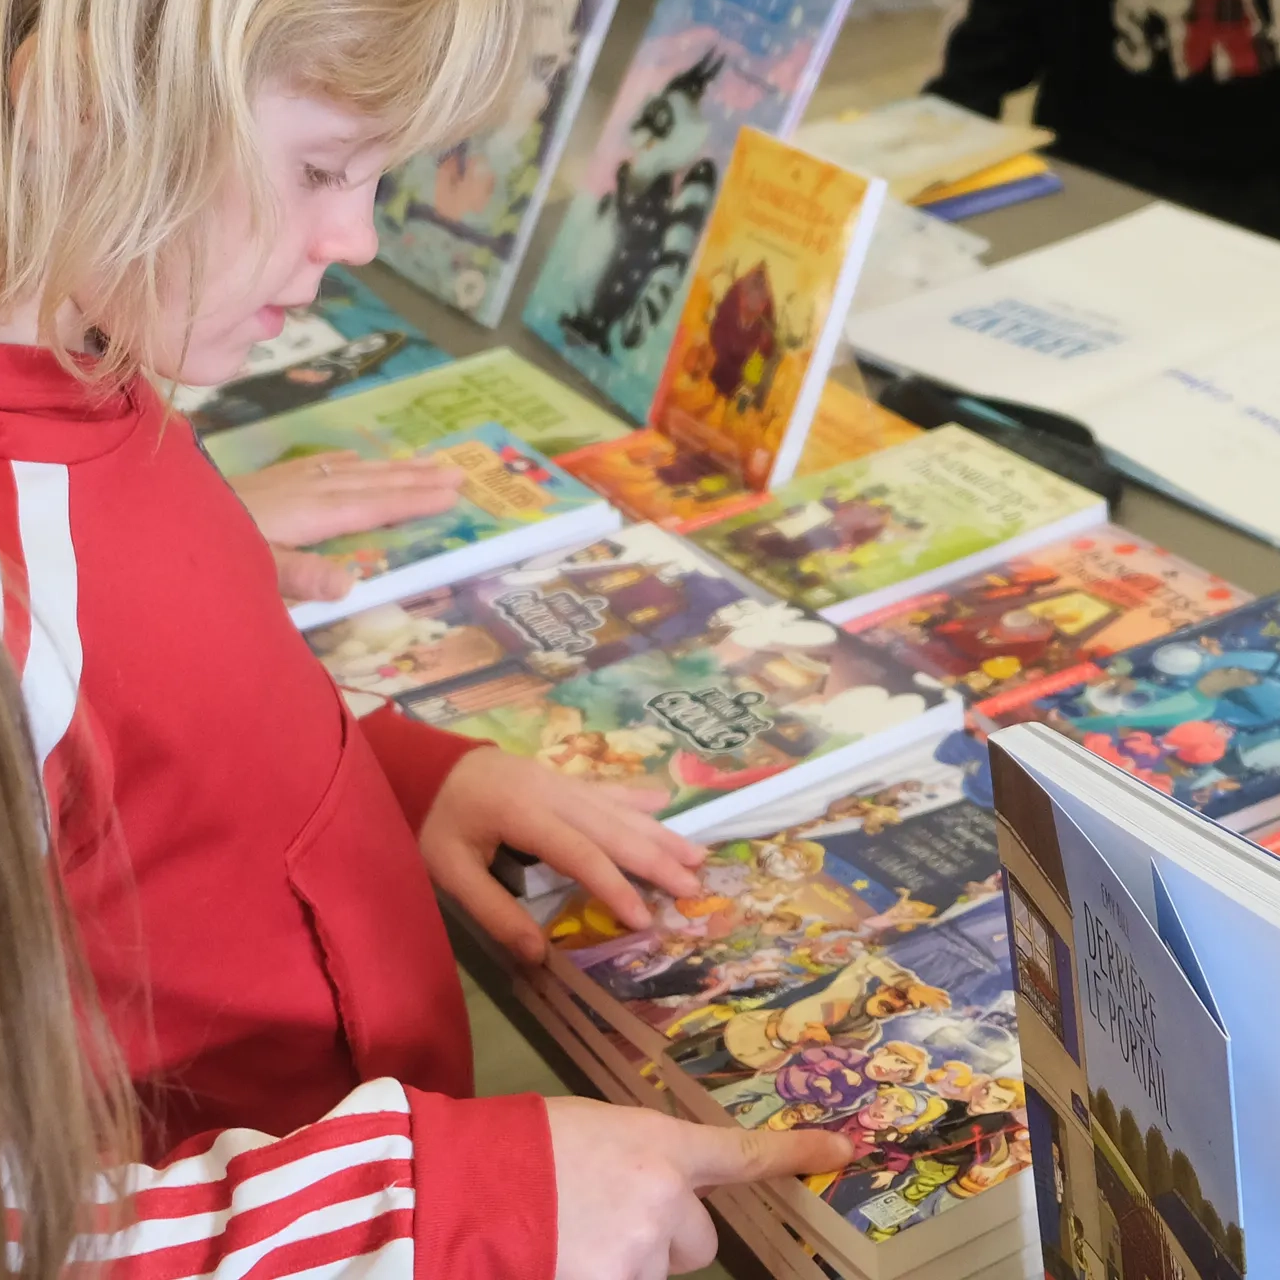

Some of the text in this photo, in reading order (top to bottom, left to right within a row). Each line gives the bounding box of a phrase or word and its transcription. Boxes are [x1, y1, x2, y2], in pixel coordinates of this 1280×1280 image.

[1082, 899, 1162, 1057] DERRIÈRE
[1084, 957, 1173, 1132] LE PORTAIL
